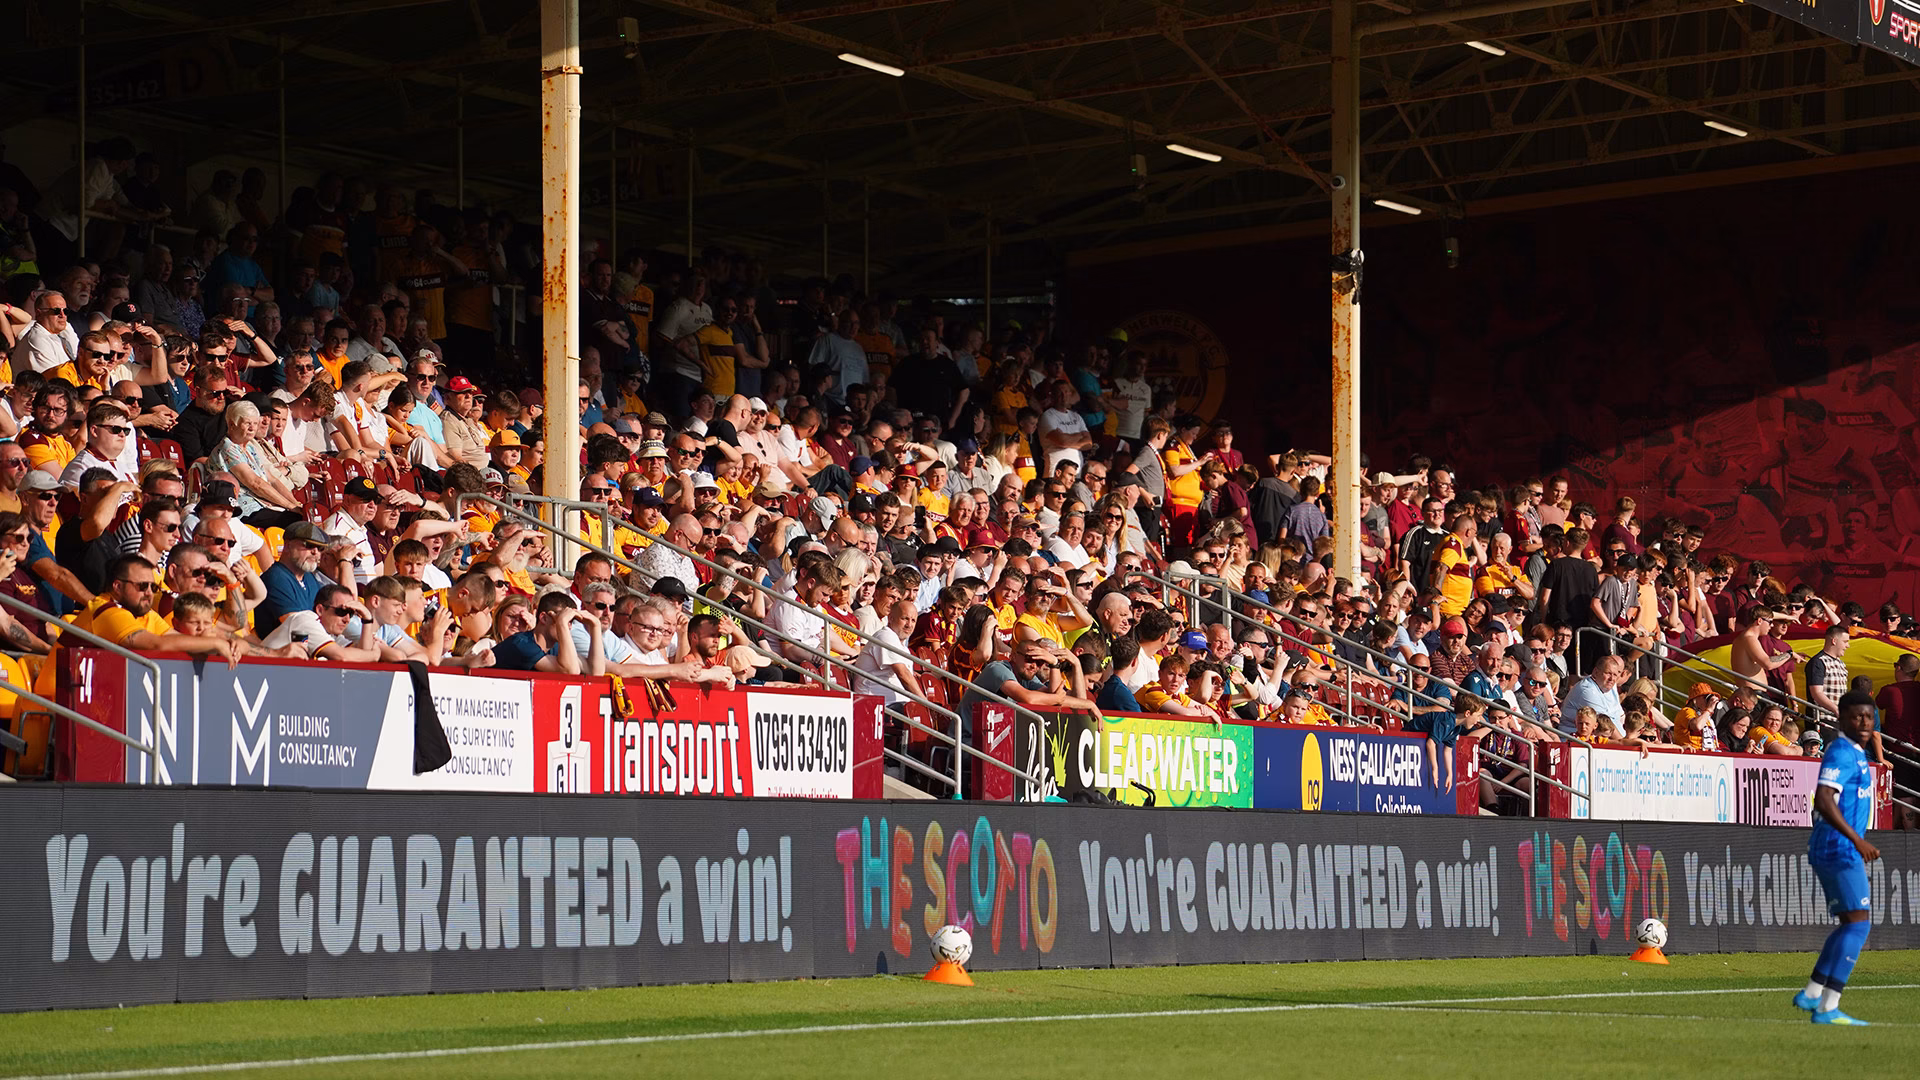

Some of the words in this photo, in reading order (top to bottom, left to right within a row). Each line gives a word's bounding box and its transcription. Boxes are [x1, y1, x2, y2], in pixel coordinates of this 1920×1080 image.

[279, 714, 330, 738] BUILDING
[408, 694, 452, 715] PECT
[456, 698, 519, 720] MANAGEMENT
[564, 703, 573, 748] 3
[279, 742, 357, 767] CONSULTANCY
[463, 727, 515, 748] SURVEYING
[599, 694, 742, 795] Transport
[755, 712, 793, 771] 07951
[798, 714, 847, 773] 534319
[1078, 728, 1239, 794] CLEARWATER
[1329, 738, 1355, 783] NESS
[1358, 741, 1422, 787] GALLAGHER
[1595, 759, 1633, 793] Instrument
[1635, 760, 1660, 804] Repairs
[1662, 764, 1674, 795] and
[1676, 764, 1713, 797] Calibration
[1772, 769, 1794, 788] FRESH
[1772, 794, 1808, 813] THINKING
[45, 822, 262, 963] You're
[278, 832, 643, 955] GUARANTEED
[657, 855, 684, 946] a
[695, 828, 793, 953] win!
[835, 815, 915, 958] THE
[1079, 832, 1199, 934] You're
[1205, 841, 1408, 932] GUARANTEED
[1415, 860, 1432, 930] a
[1437, 839, 1500, 937] win!
[1518, 830, 1569, 942] THE
[1683, 845, 1755, 926] You're
[1891, 868, 1903, 925] a
